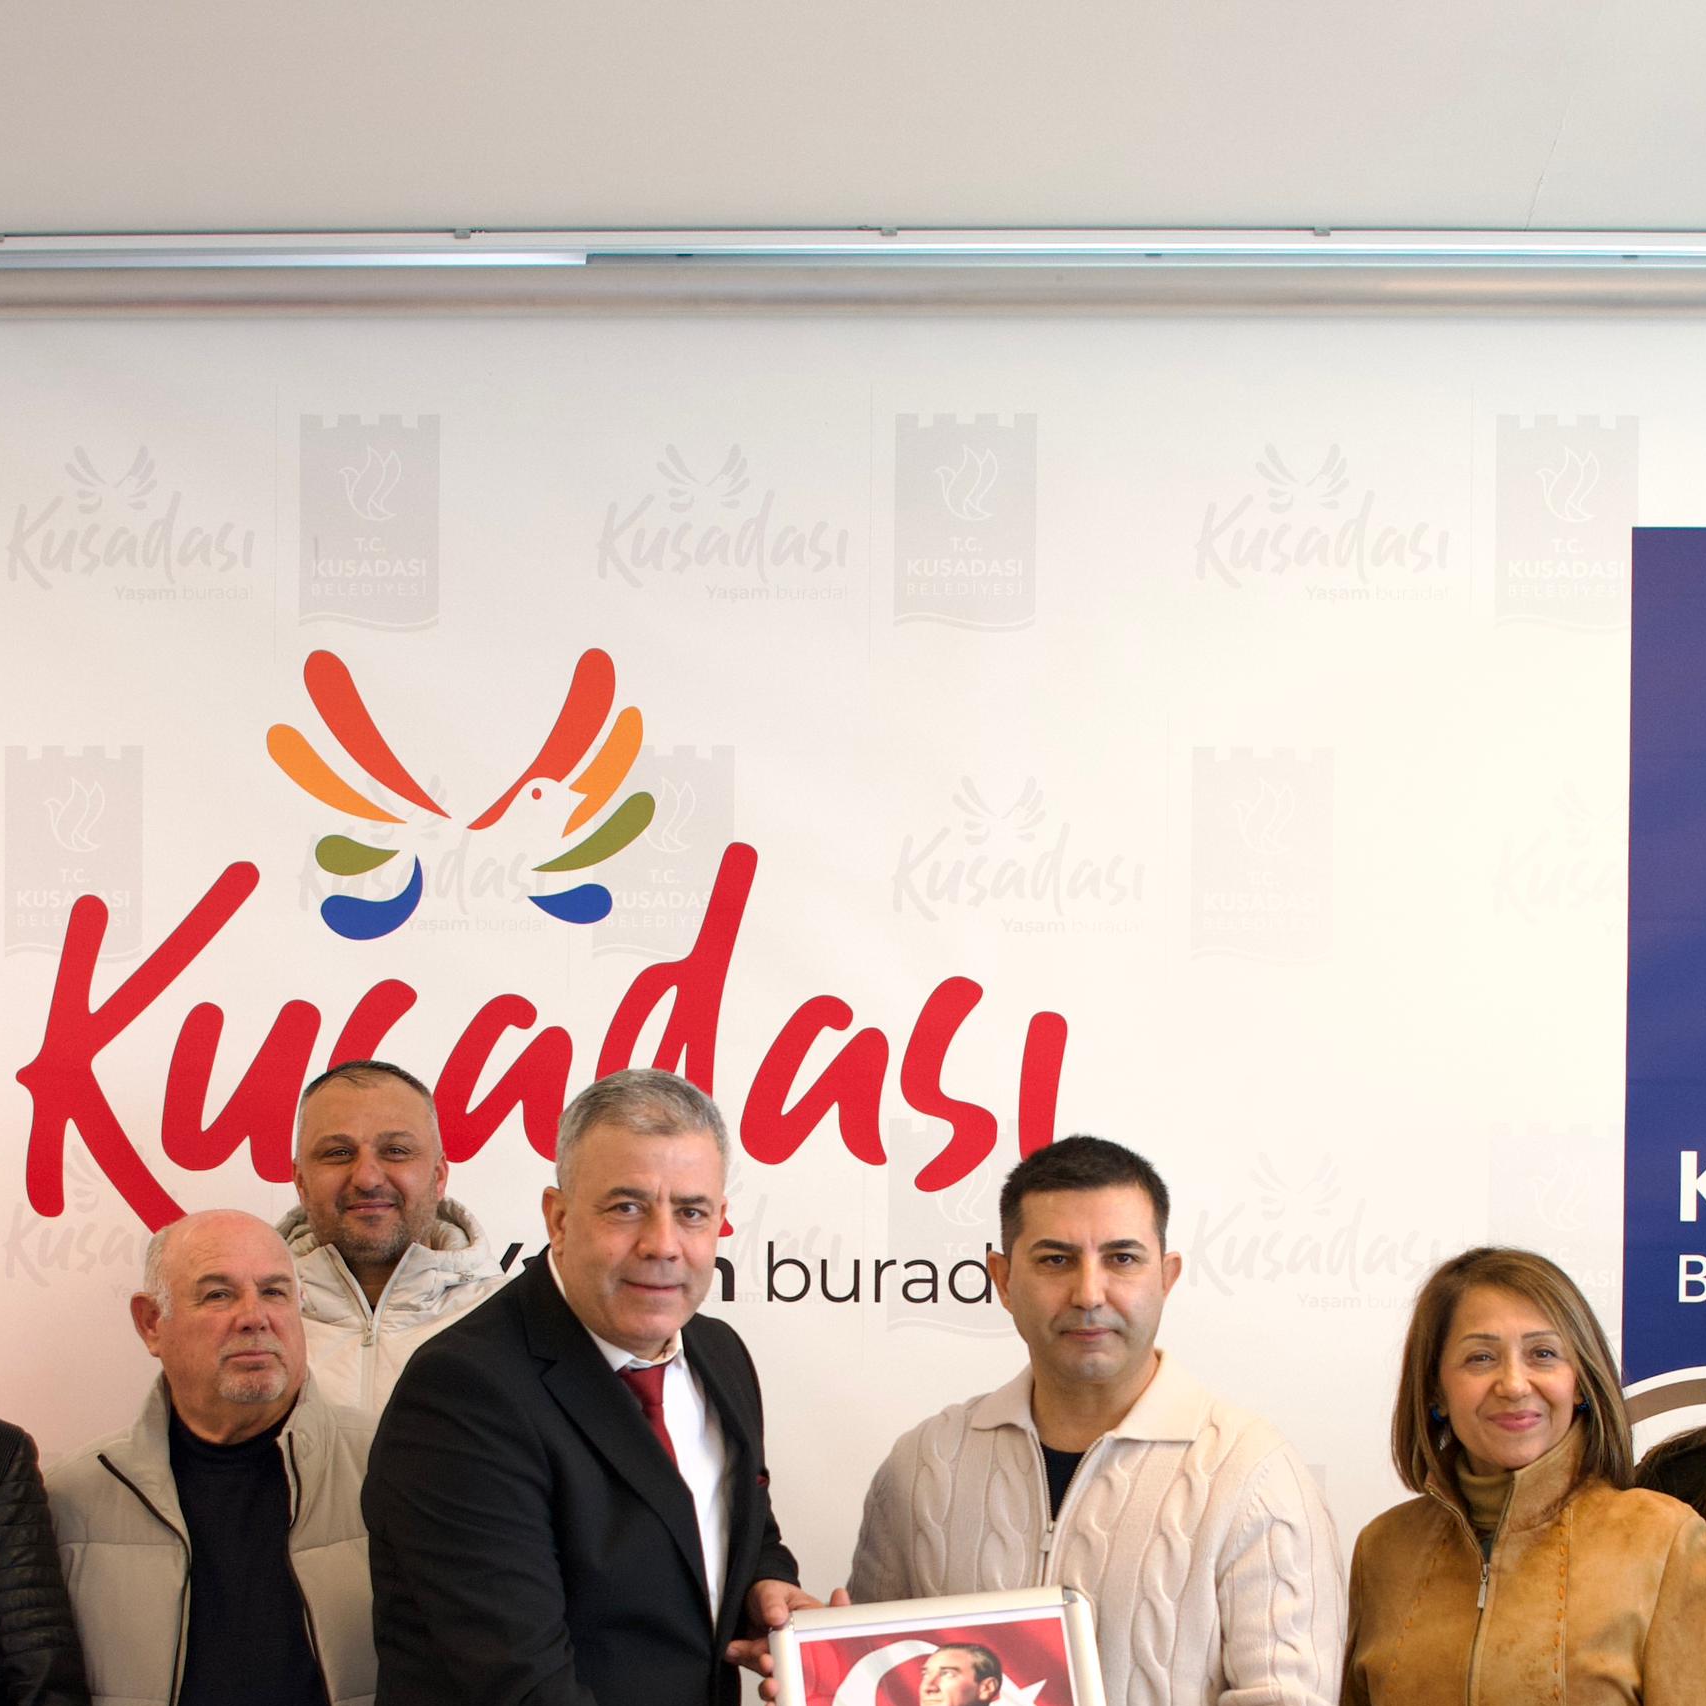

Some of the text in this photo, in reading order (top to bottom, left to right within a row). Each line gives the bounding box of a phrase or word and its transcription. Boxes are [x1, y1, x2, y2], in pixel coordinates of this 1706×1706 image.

[354, 537, 386, 552] T.C.
[950, 537, 982, 552] T.C.
[767, 1239, 995, 1304] burad
